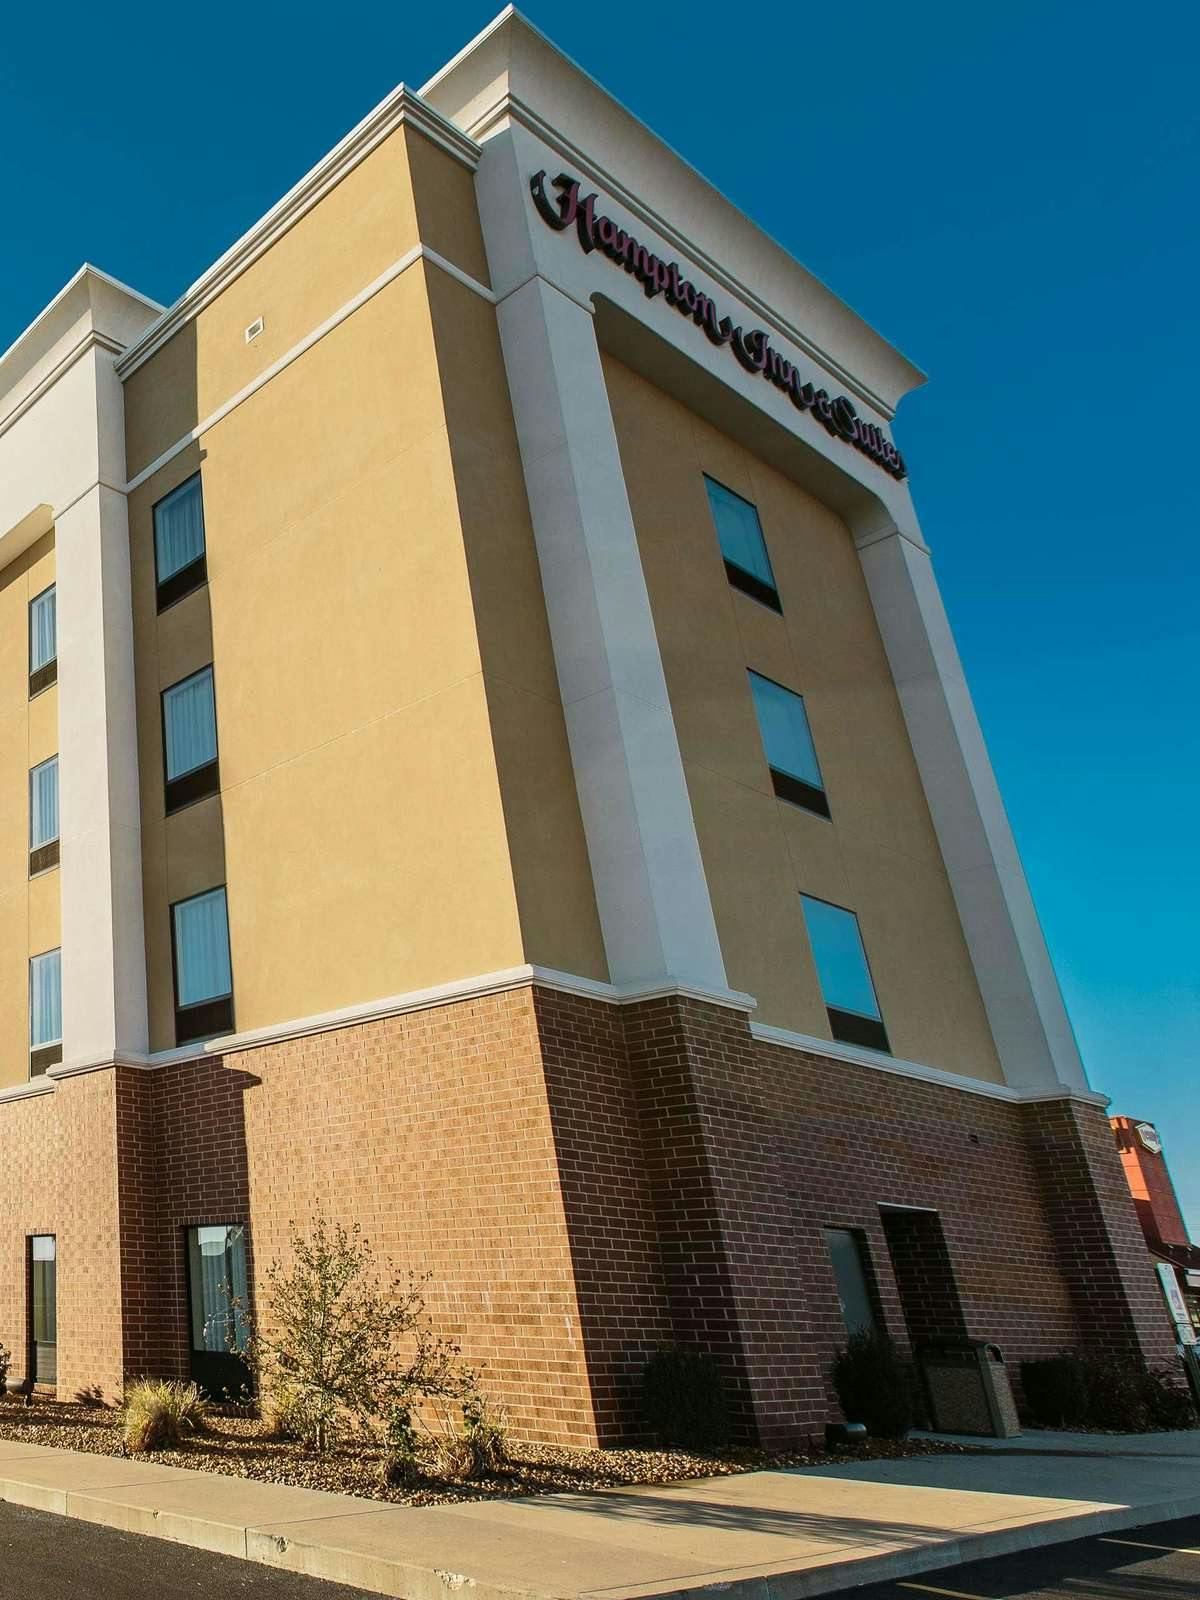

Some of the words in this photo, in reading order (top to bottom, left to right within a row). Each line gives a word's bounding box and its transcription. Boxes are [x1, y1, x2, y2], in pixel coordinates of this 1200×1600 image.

[529, 169, 734, 347] Hampton
[730, 326, 816, 412] Inn
[830, 395, 907, 481] Suites
